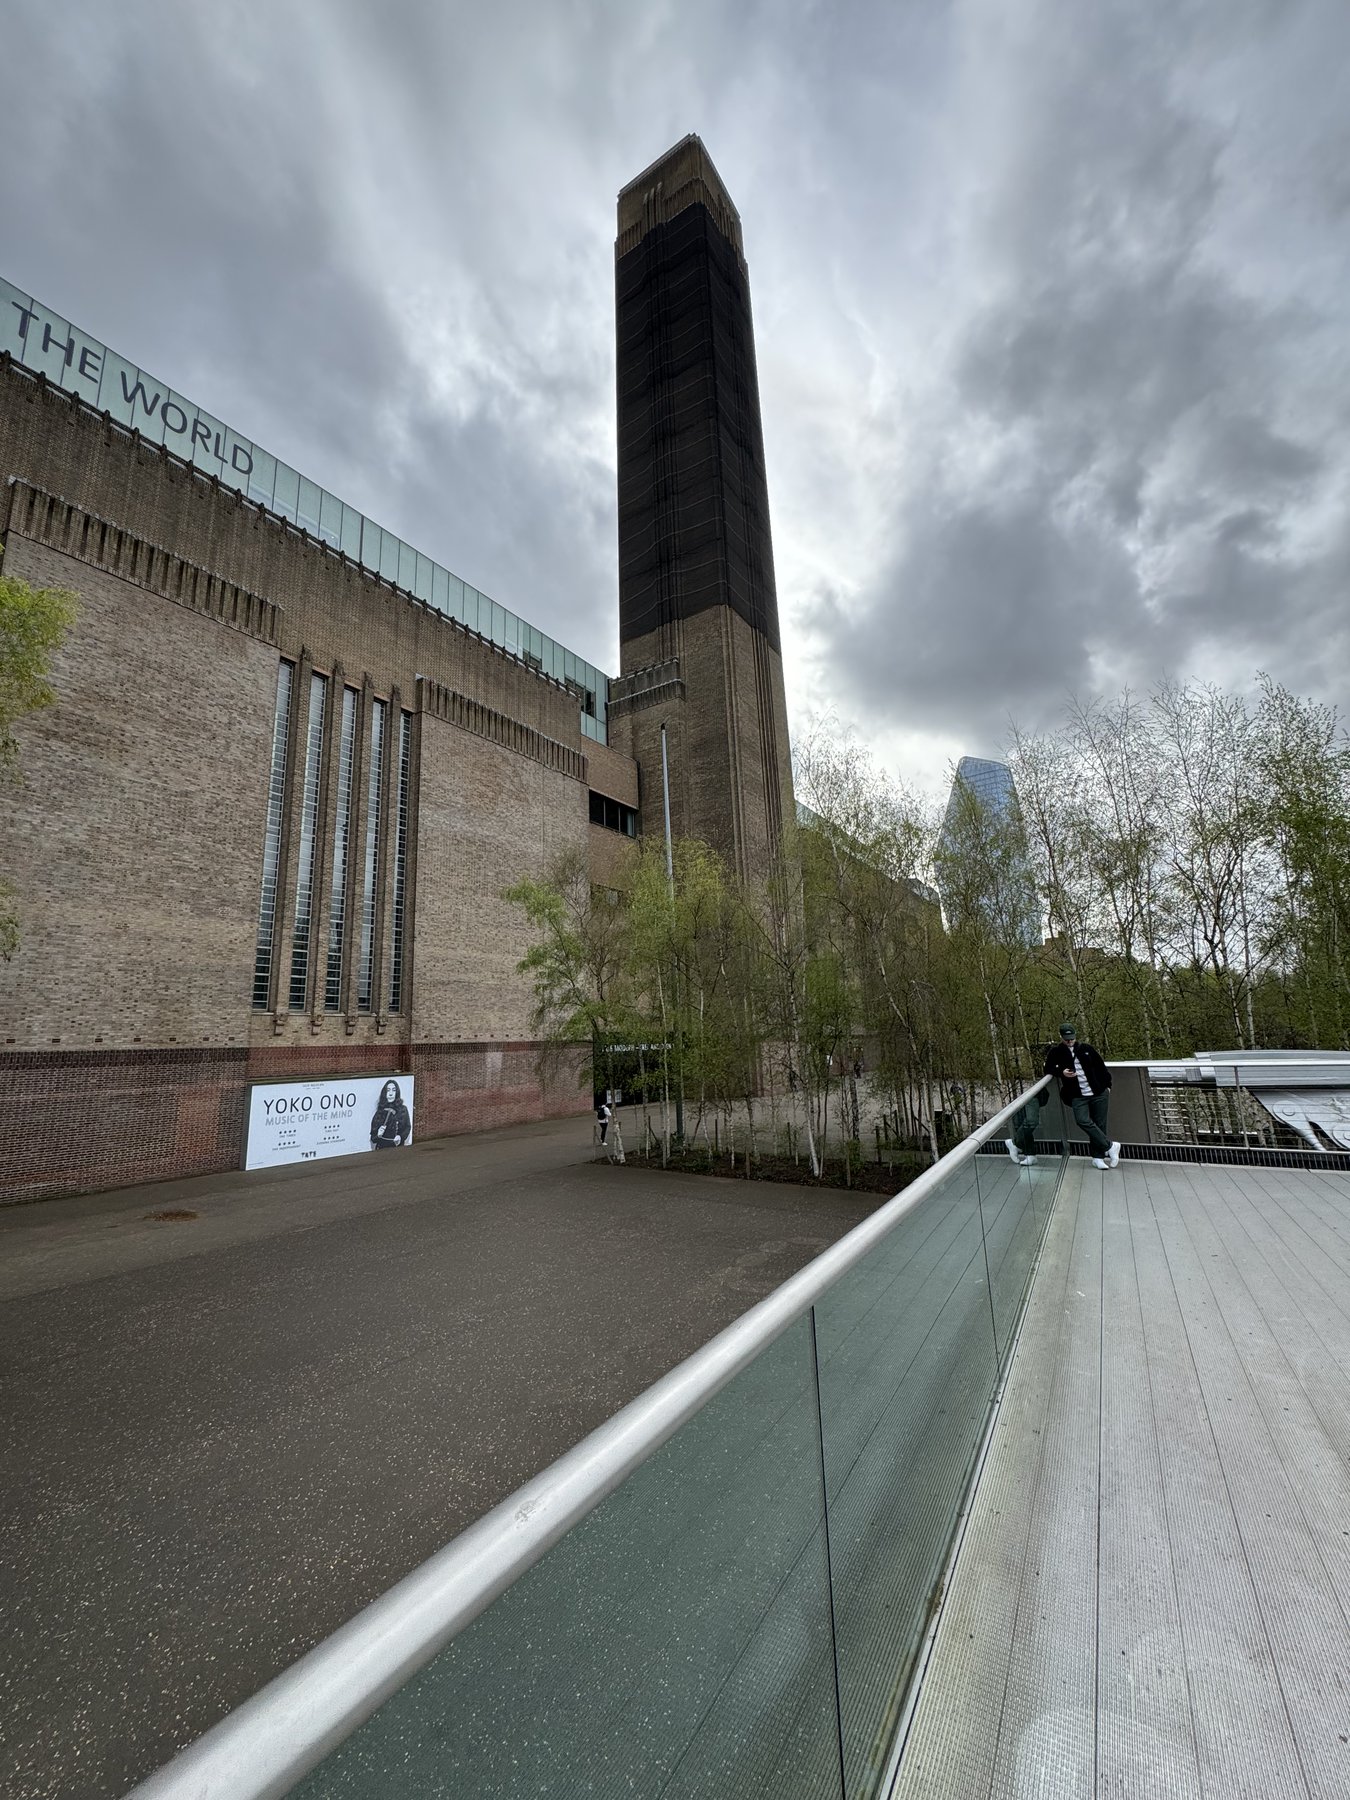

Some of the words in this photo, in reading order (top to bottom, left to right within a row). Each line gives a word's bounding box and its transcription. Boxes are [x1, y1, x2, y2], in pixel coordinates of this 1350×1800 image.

[11, 301, 102, 384] THE
[120, 370, 254, 475] WORLD
[263, 1096, 312, 1115] YOKO
[320, 1092, 357, 1110] ONO
[265, 1114, 296, 1127] MUSIC
[297, 1113, 310, 1123] OF
[312, 1111, 328, 1121] THE
[330, 1109, 353, 1120] MIND
